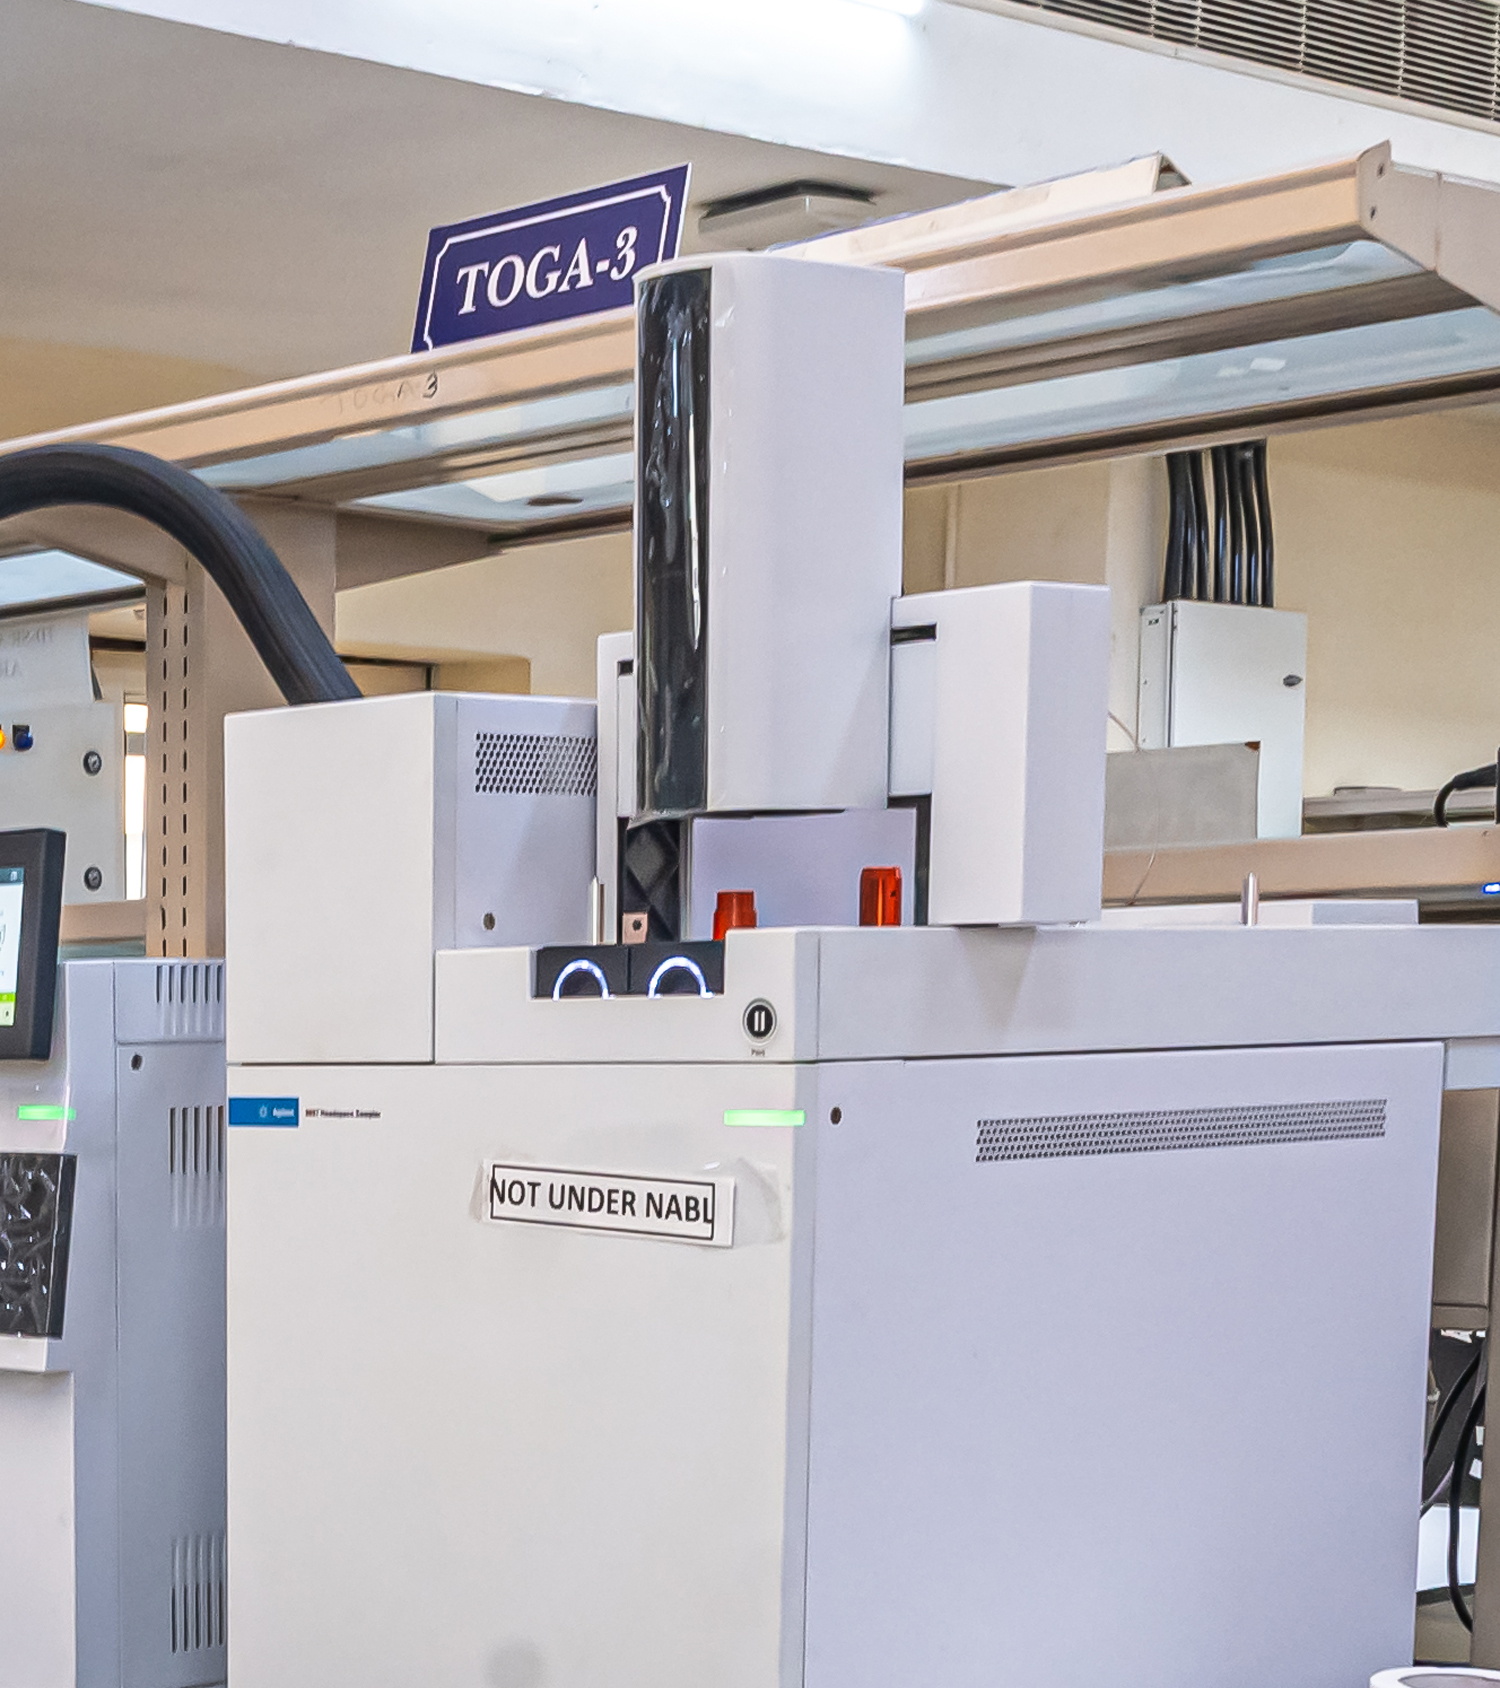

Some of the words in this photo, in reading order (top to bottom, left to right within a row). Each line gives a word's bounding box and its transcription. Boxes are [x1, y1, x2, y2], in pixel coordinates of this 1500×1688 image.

[456, 225, 638, 316] TOGA-3
[490, 1177, 541, 1207] NOT
[549, 1182, 637, 1217] UNDER
[646, 1192, 713, 1224] NABL
